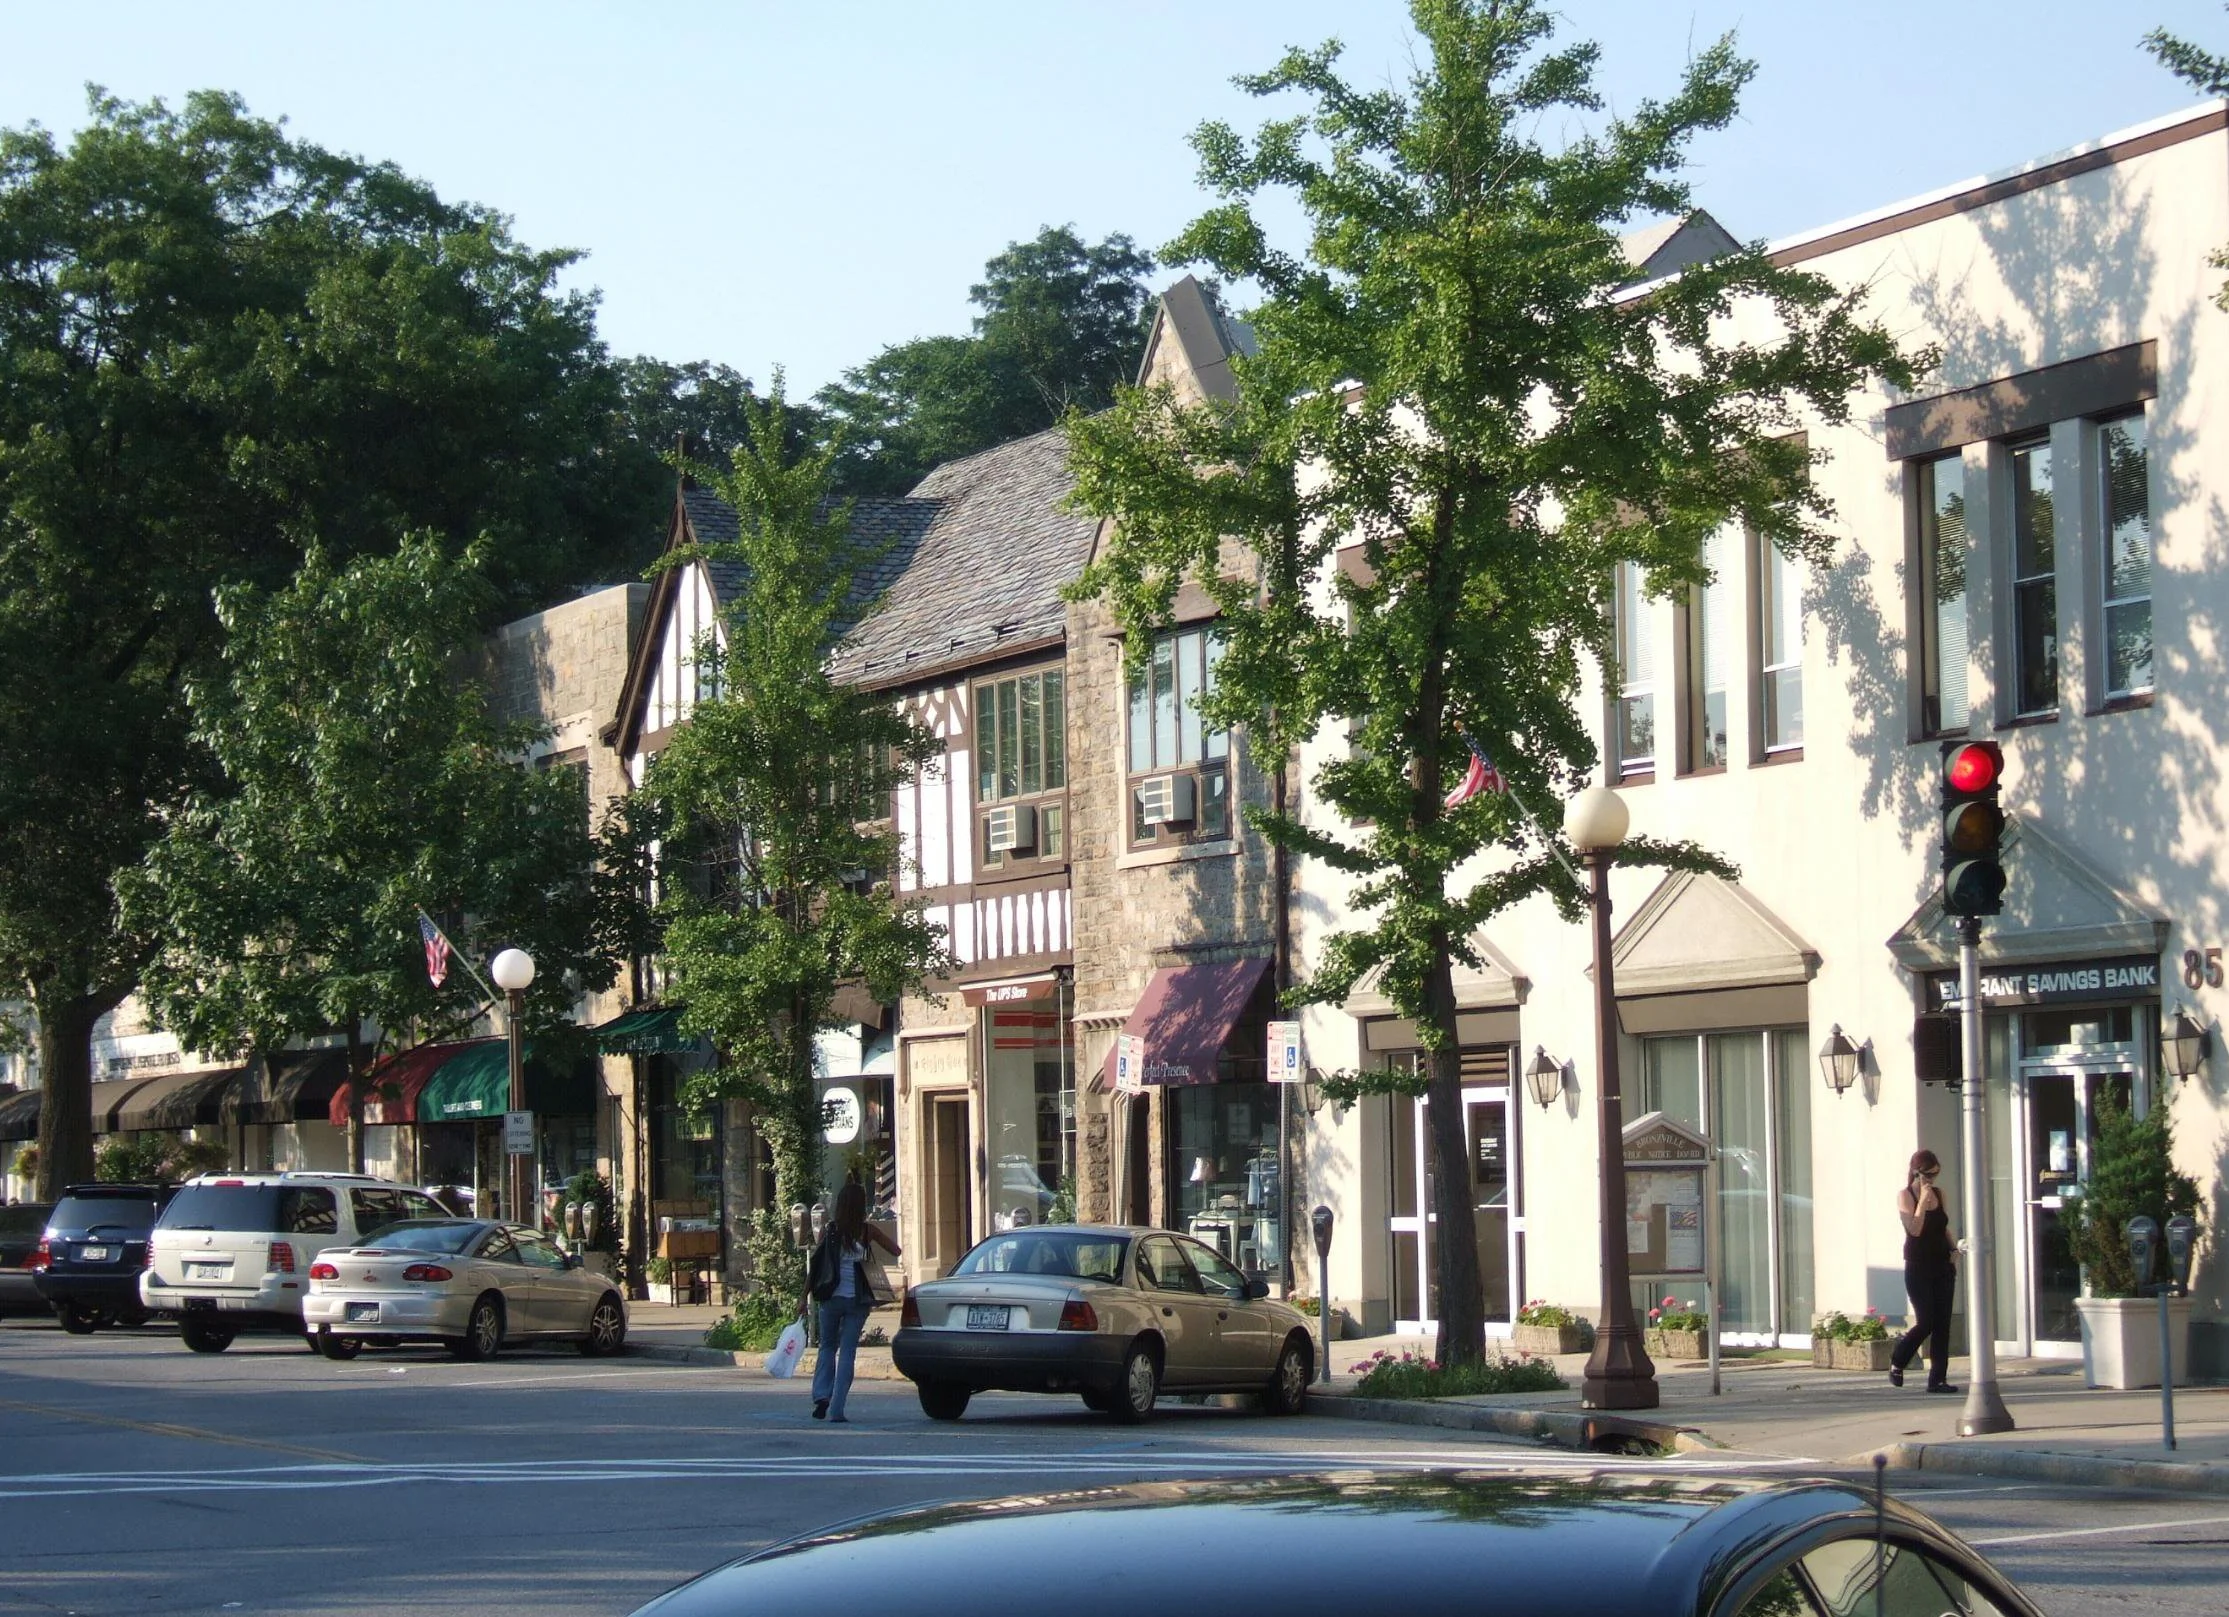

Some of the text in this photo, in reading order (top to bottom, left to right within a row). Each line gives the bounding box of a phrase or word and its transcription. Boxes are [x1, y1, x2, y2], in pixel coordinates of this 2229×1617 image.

[1940, 966, 2155, 1000] EMRANT SAVINGS BANK
[2184, 949, 2224, 991] 85
[987, 986, 1027, 1002] The UPS Store
